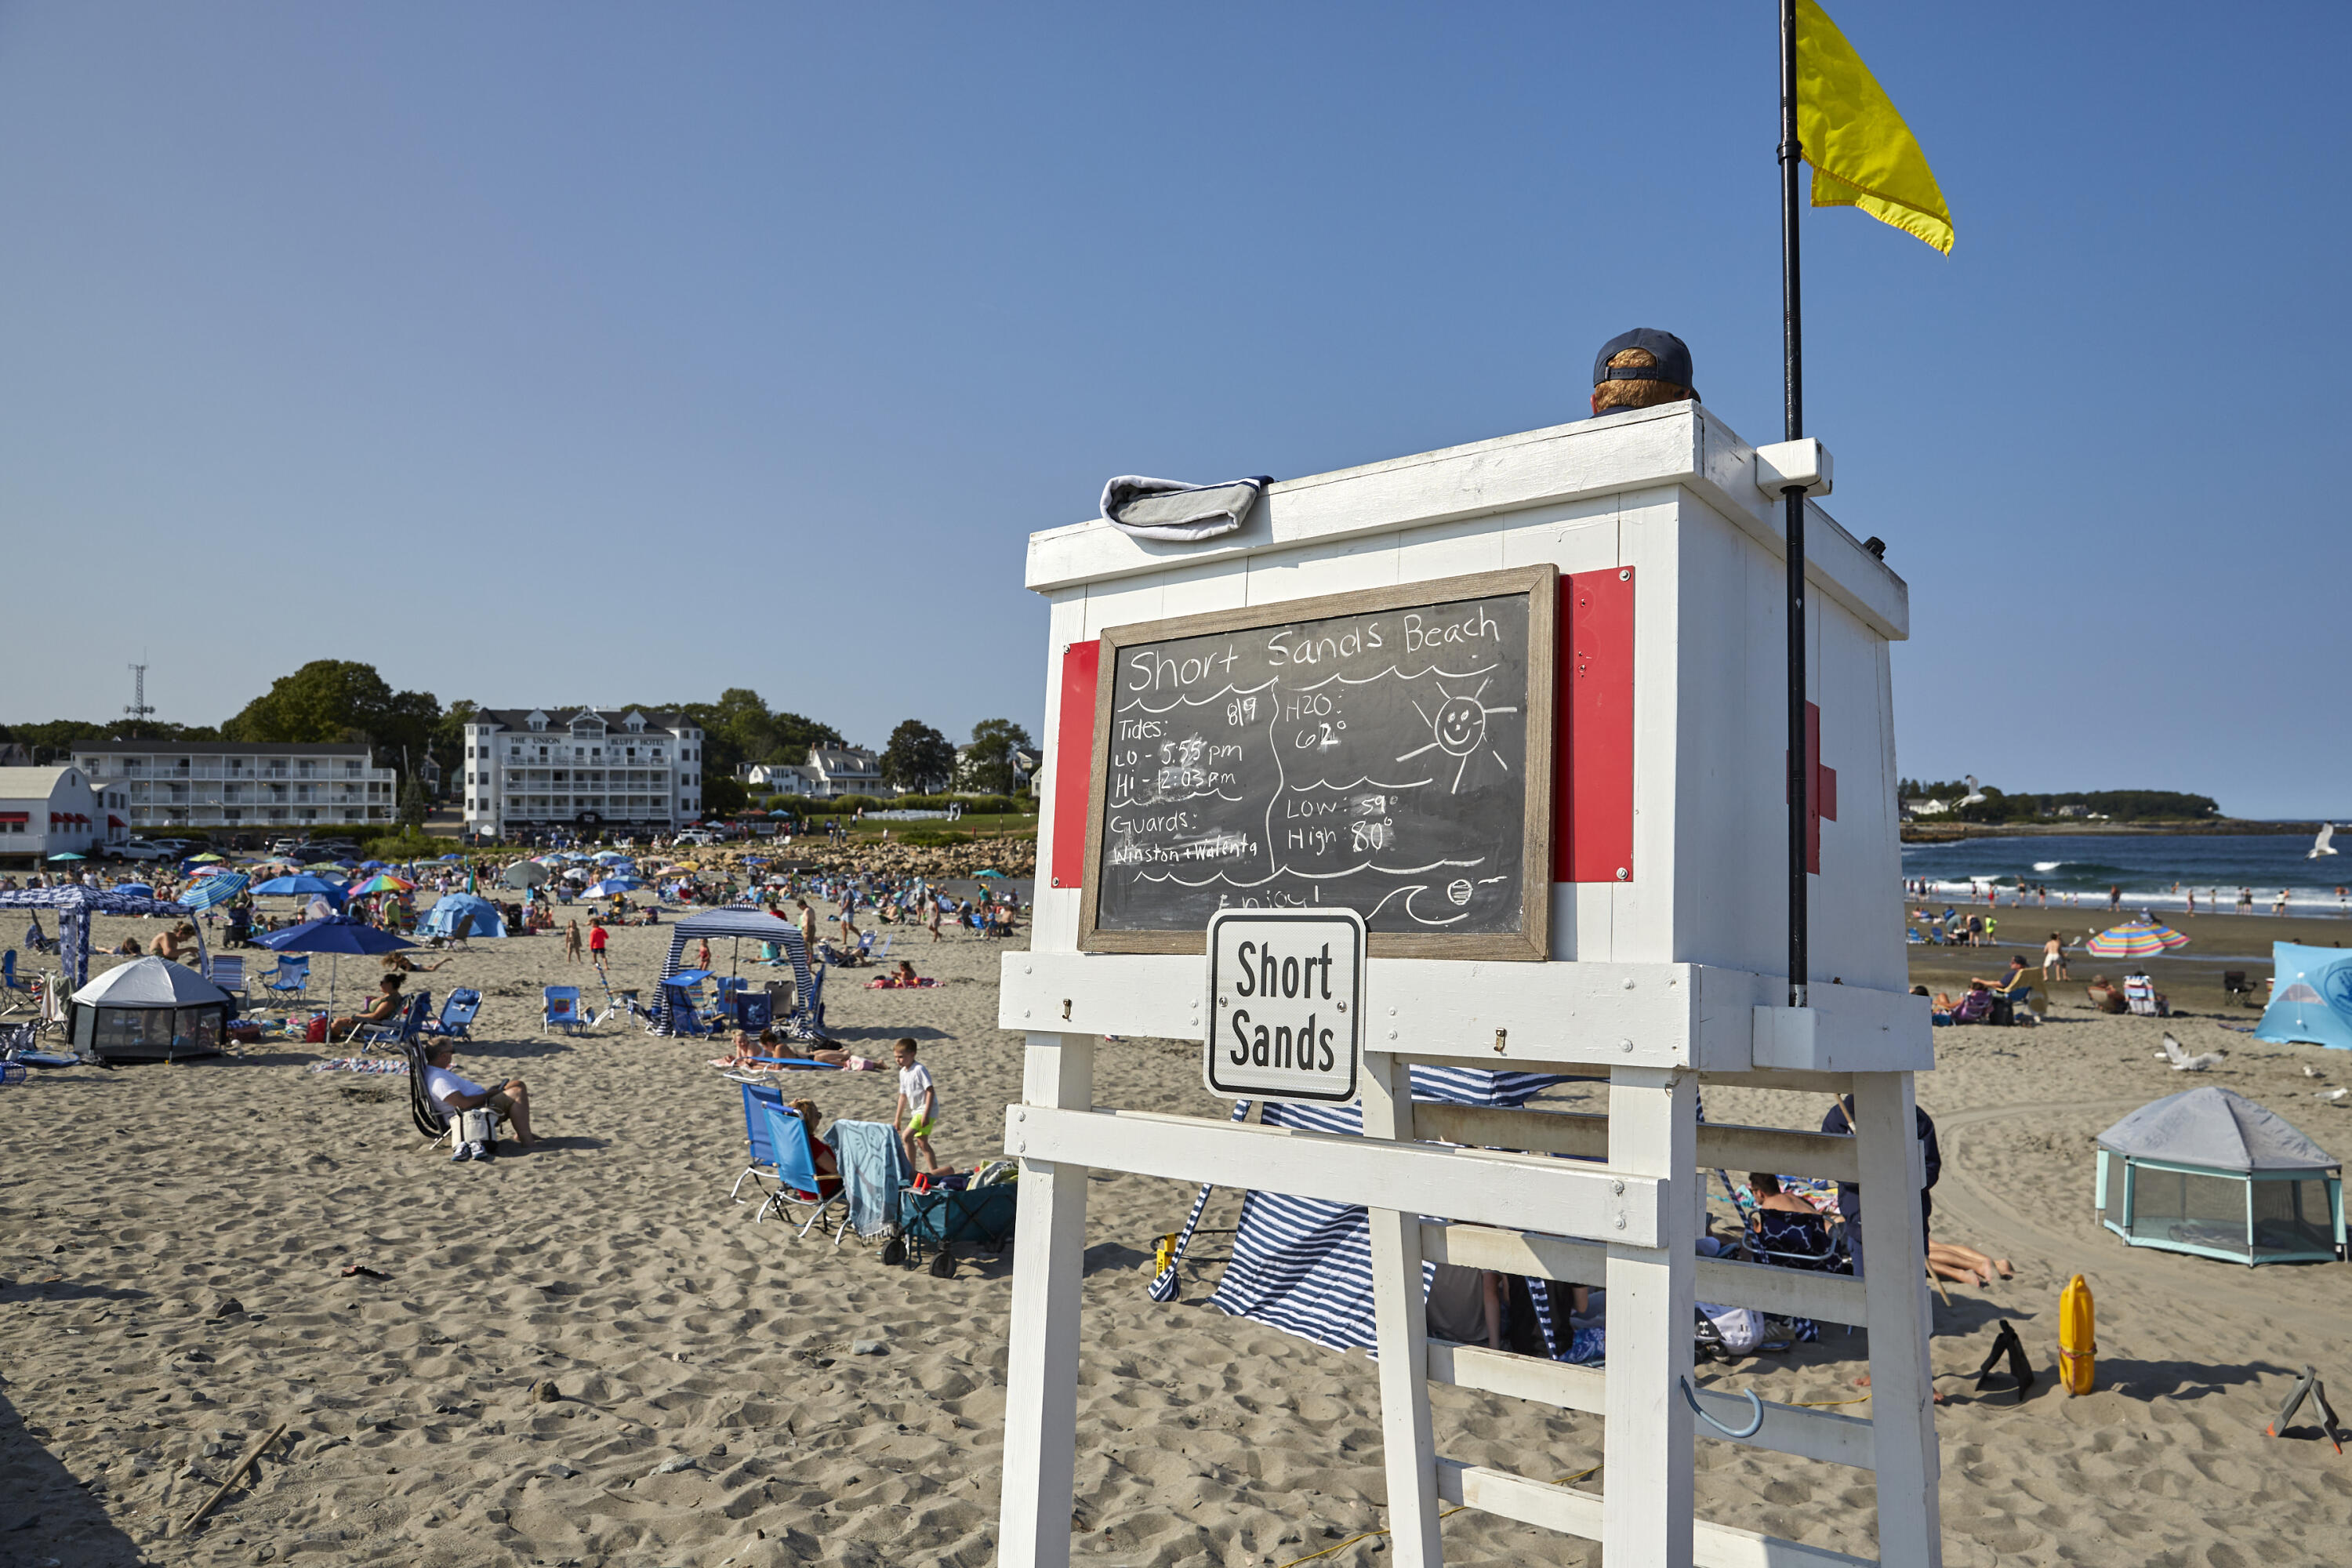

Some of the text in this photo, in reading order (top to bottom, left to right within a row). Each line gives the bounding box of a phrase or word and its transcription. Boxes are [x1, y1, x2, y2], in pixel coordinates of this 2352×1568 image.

[1129, 606, 1501, 690] Short Sands Beach
[1118, 718, 1168, 740] Tides:
[1209, 745, 1242, 765] pm
[1208, 772, 1236, 787] pm
[1110, 811, 1198, 833] Guards:
[1236, 941, 1332, 1000] Short
[1230, 1009, 1334, 1072] Sands
